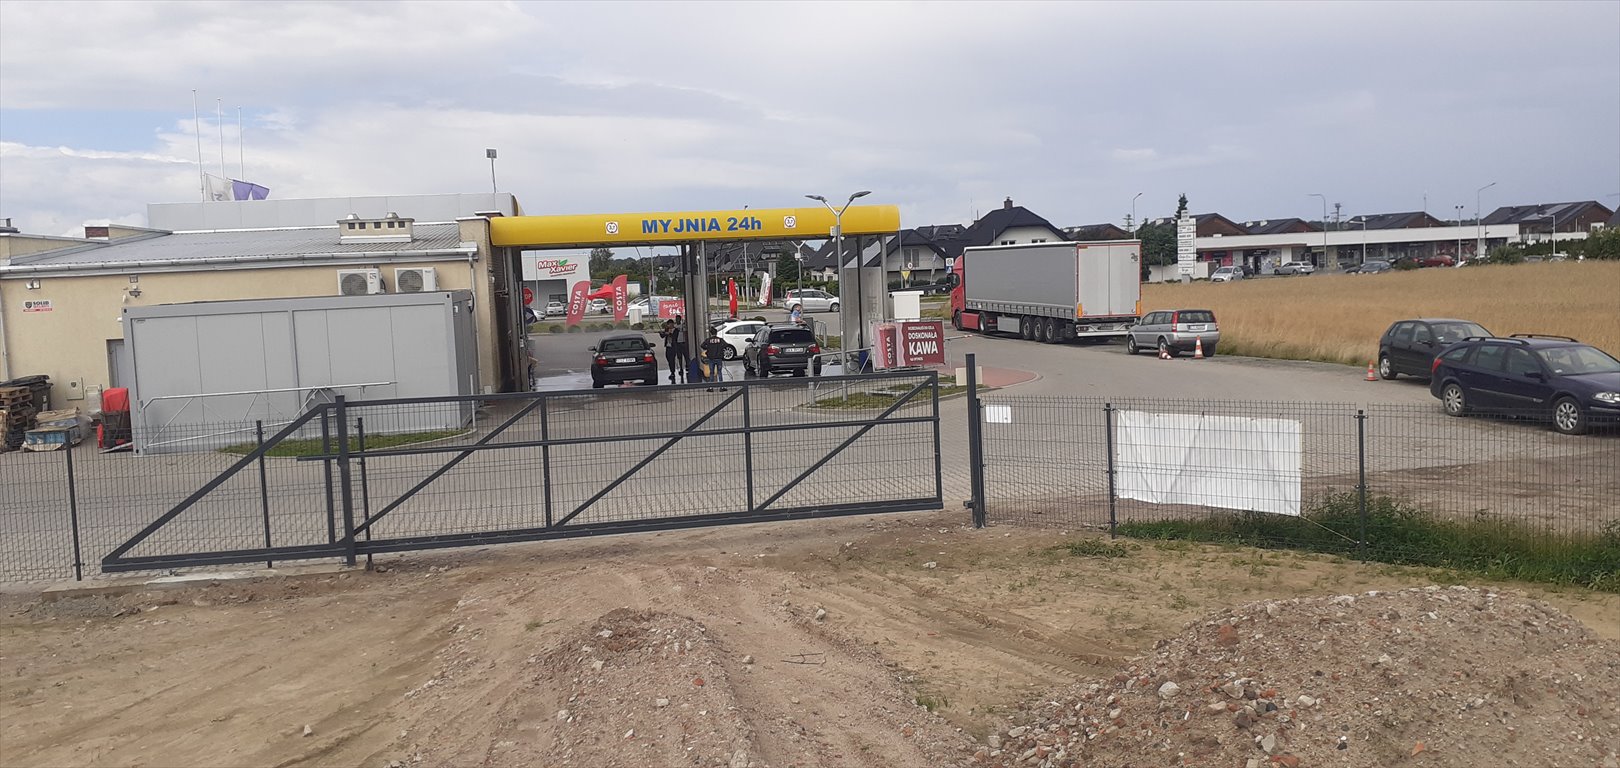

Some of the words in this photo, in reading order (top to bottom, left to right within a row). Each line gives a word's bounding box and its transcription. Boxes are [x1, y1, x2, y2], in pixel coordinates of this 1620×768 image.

[642, 218, 721, 233] MYJNIA
[727, 217, 762, 231] 24h
[538, 260, 558, 270] Max
[550, 264, 577, 274] Xavier
[571, 290, 582, 315] COSTA
[885, 336, 893, 365] COSTA
[908, 341, 939, 356] KAWA
